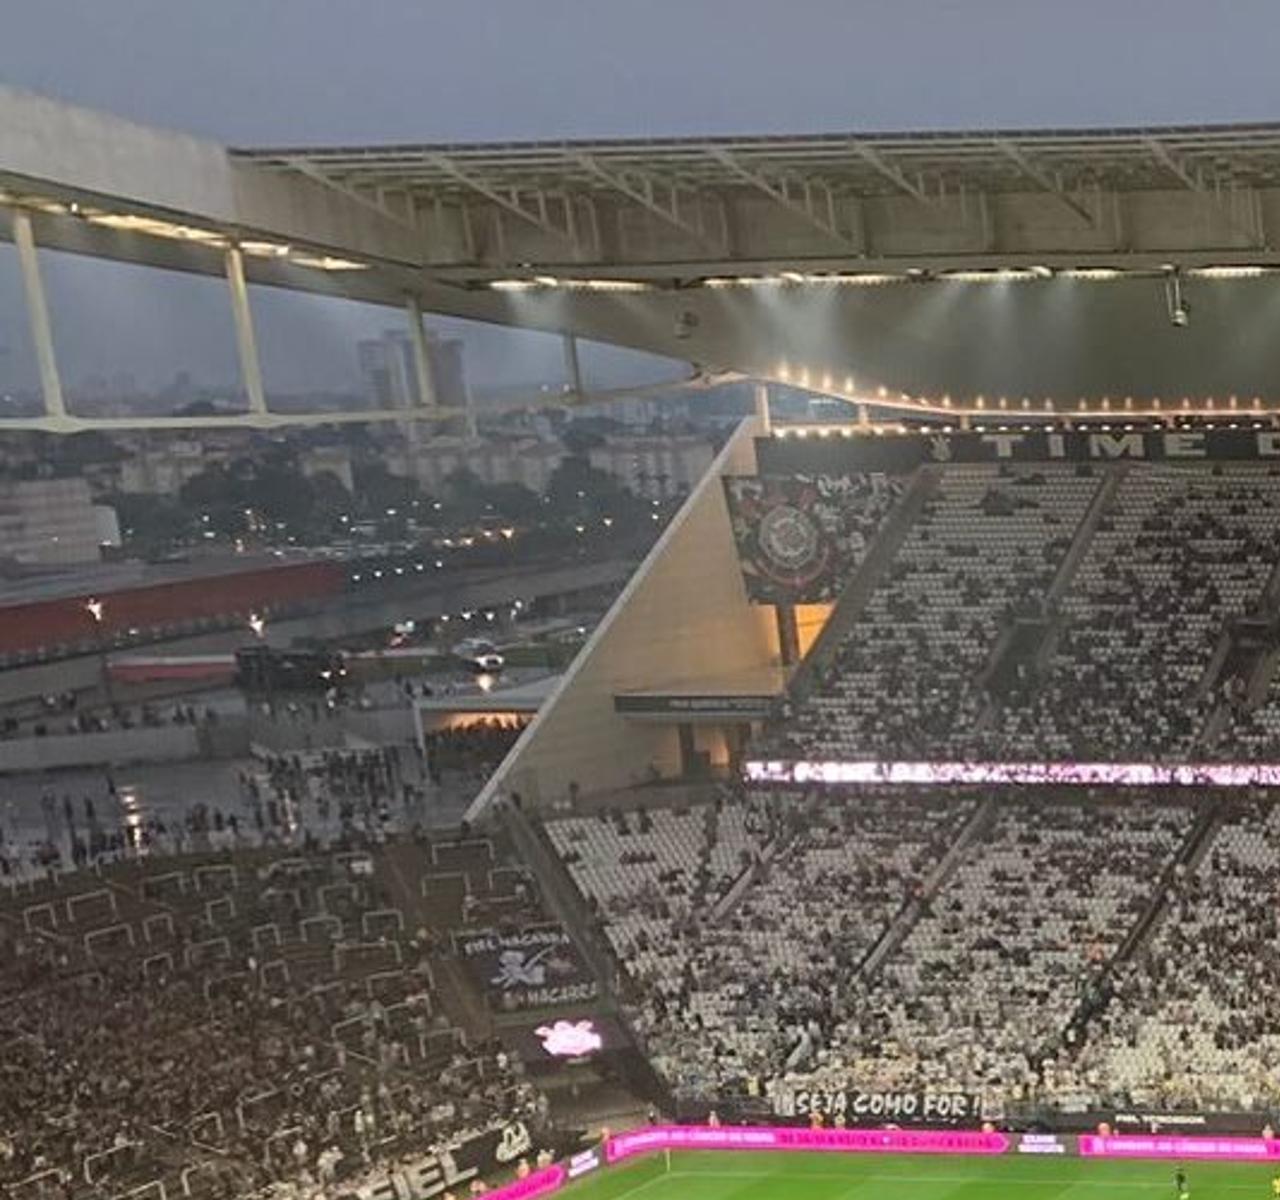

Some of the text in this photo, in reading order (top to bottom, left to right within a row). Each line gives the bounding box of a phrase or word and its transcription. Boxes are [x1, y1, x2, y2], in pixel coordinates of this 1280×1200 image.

[981, 433, 1207, 457] TIME
[796, 1091, 847, 1114] SEJA
[853, 1093, 918, 1116] COMO
